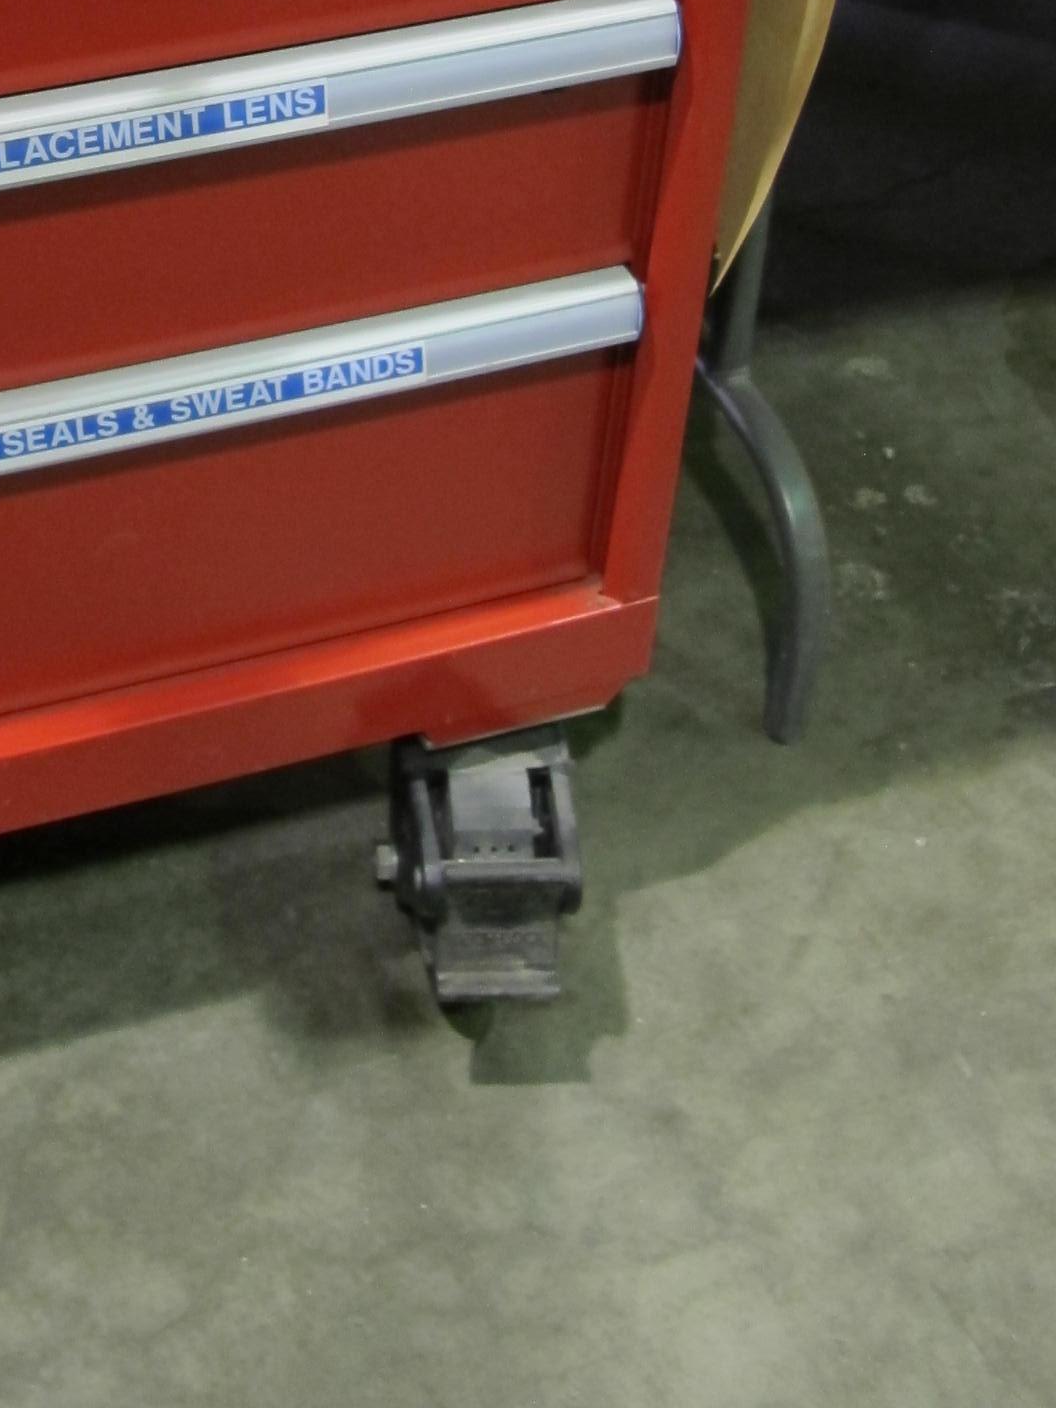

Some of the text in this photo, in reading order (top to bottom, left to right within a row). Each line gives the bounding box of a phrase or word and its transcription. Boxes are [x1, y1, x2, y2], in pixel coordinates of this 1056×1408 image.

[222, 88, 318, 131] LENS
[3, 409, 120, 456] SEALS
[132, 404, 155, 431] &
[170, 375, 288, 423] SWEAT
[302, 348, 417, 396] BANDS
